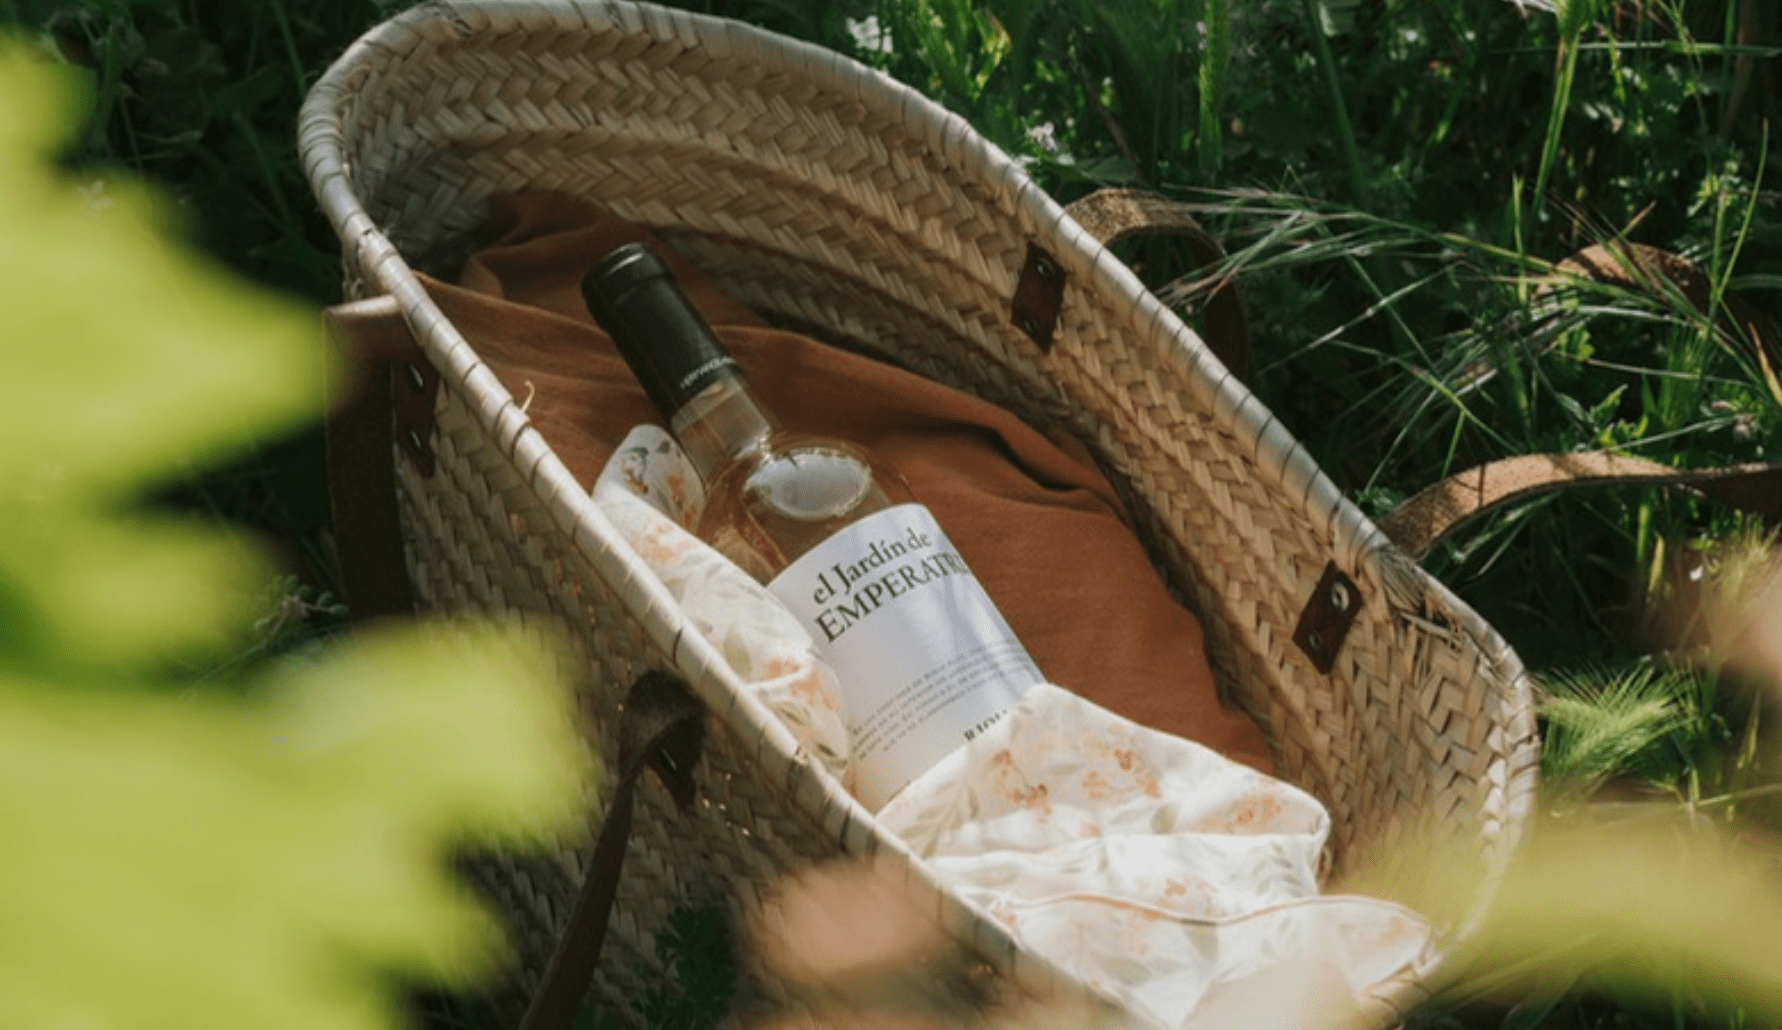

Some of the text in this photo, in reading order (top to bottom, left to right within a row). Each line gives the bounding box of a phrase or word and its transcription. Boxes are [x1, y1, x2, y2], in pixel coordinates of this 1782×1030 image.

[814, 526, 932, 605] el Jardín de
